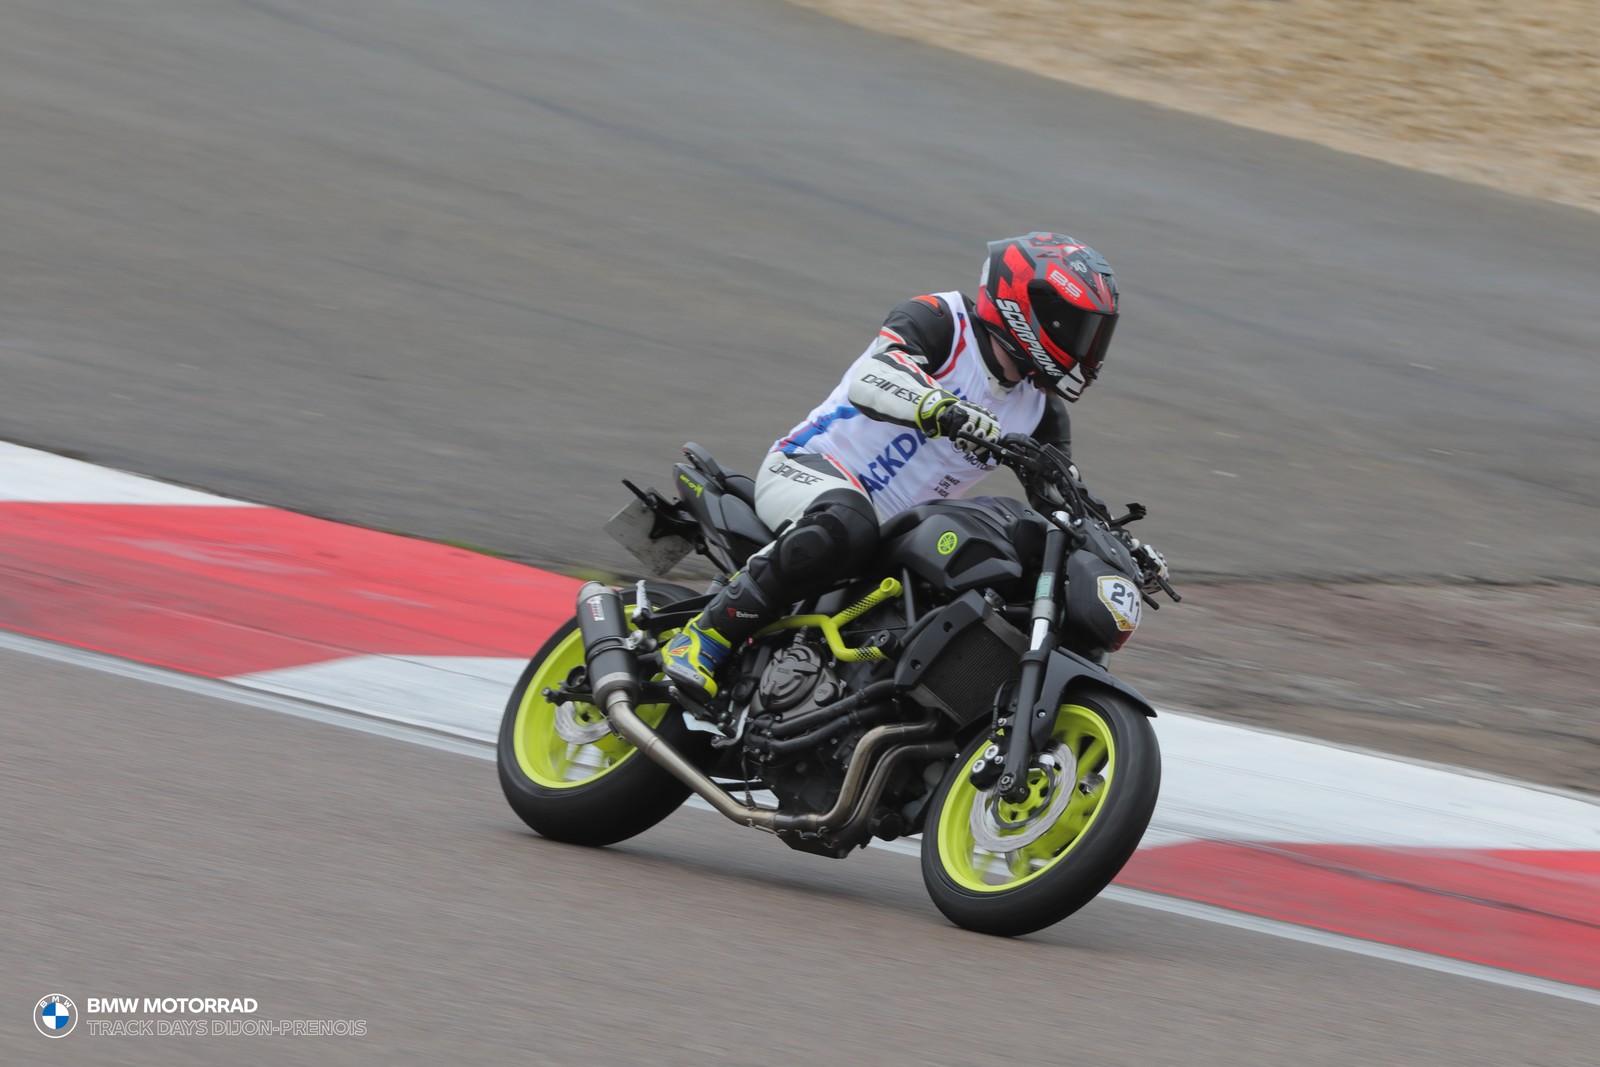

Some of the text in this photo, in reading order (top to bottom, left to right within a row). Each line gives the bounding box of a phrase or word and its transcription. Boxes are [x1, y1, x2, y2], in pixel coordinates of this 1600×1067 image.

[1050, 270, 1083, 298] BS
[996, 299, 1060, 374] SCORPION
[860, 373, 922, 405] DAINESE
[768, 462, 824, 486] DAINESE
[1110, 582, 1140, 622] 21
